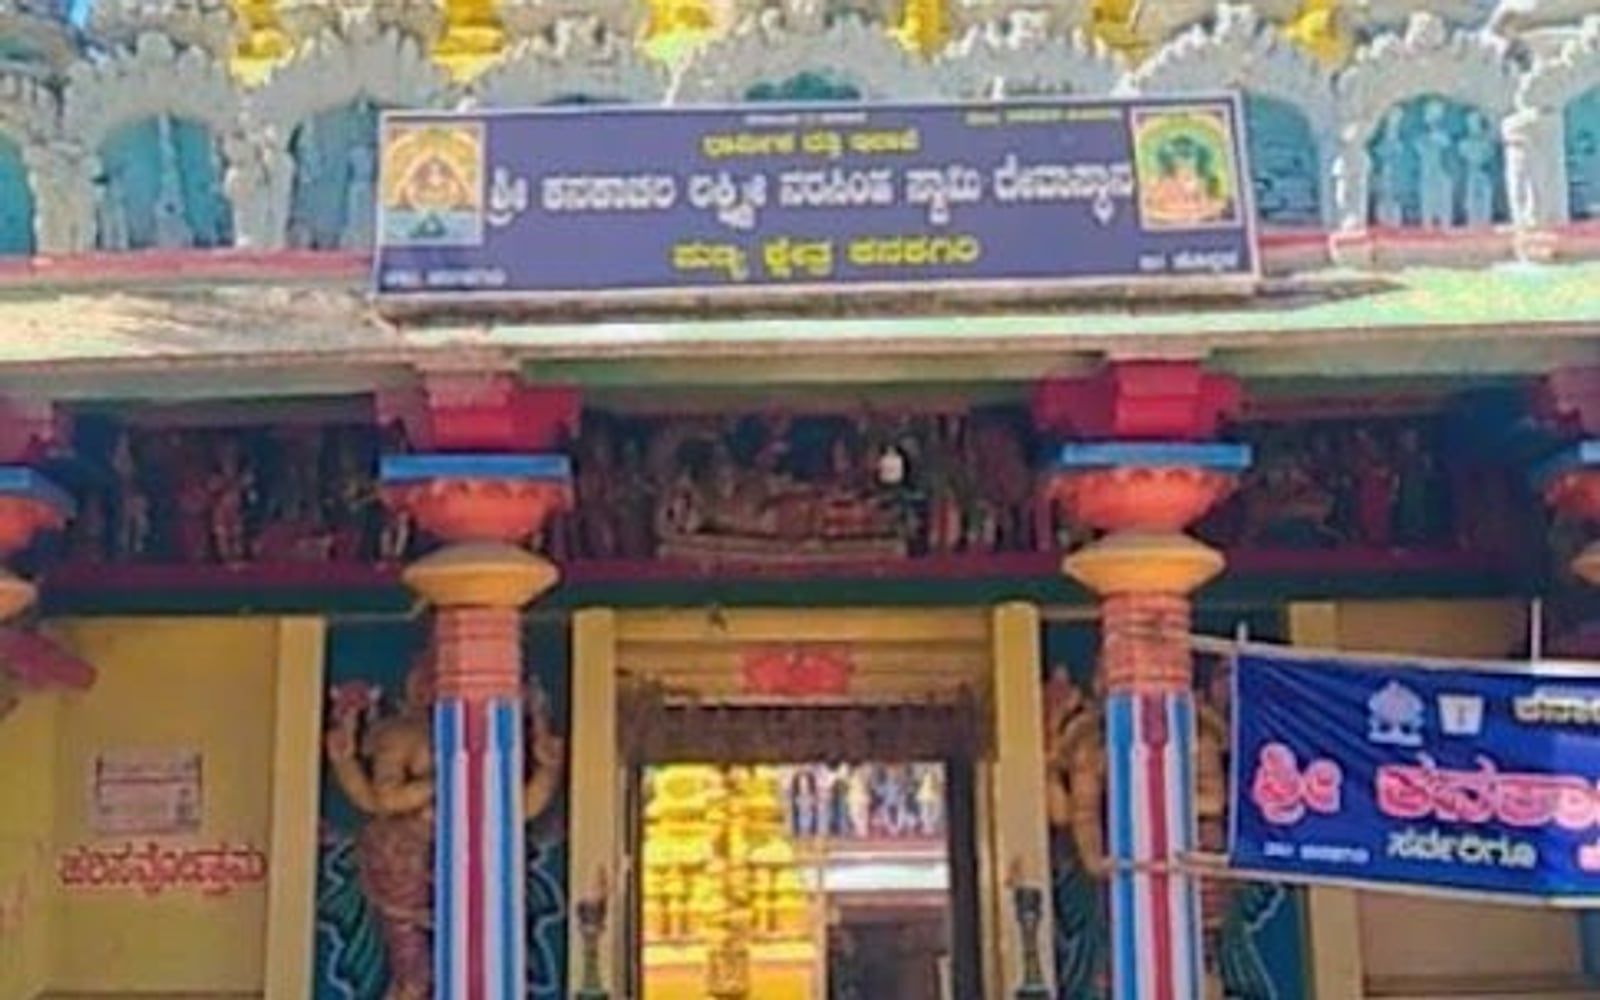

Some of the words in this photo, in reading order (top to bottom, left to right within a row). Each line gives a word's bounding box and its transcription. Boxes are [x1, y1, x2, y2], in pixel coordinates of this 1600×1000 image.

[487, 167, 528, 226] ಶ್ರೀ
[779, 165, 894, 206] ನರಸಿಂಹ
[906, 164, 981, 225] ಸ್ವಾಮಿ
[1254, 742, 1343, 825] ಶ್ರೀ
